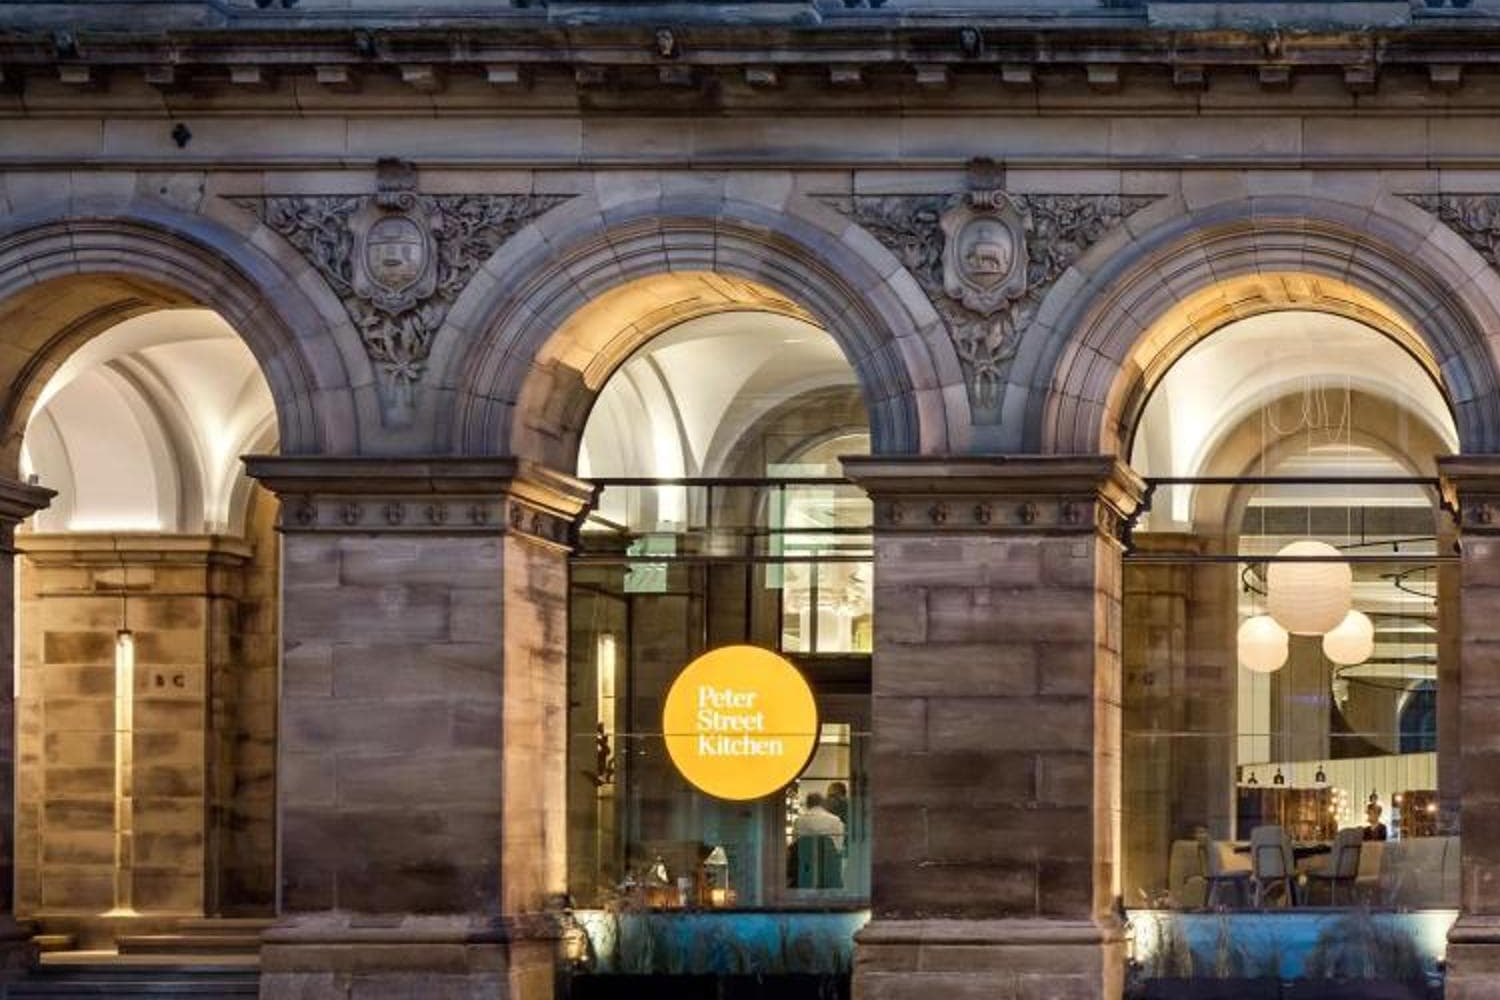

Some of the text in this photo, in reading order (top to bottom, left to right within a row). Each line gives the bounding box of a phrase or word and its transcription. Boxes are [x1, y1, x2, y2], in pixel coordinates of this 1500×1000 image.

[698, 686, 757, 709] Peter
[697, 710, 765, 731] Street
[698, 734, 783, 757] Kitchen
